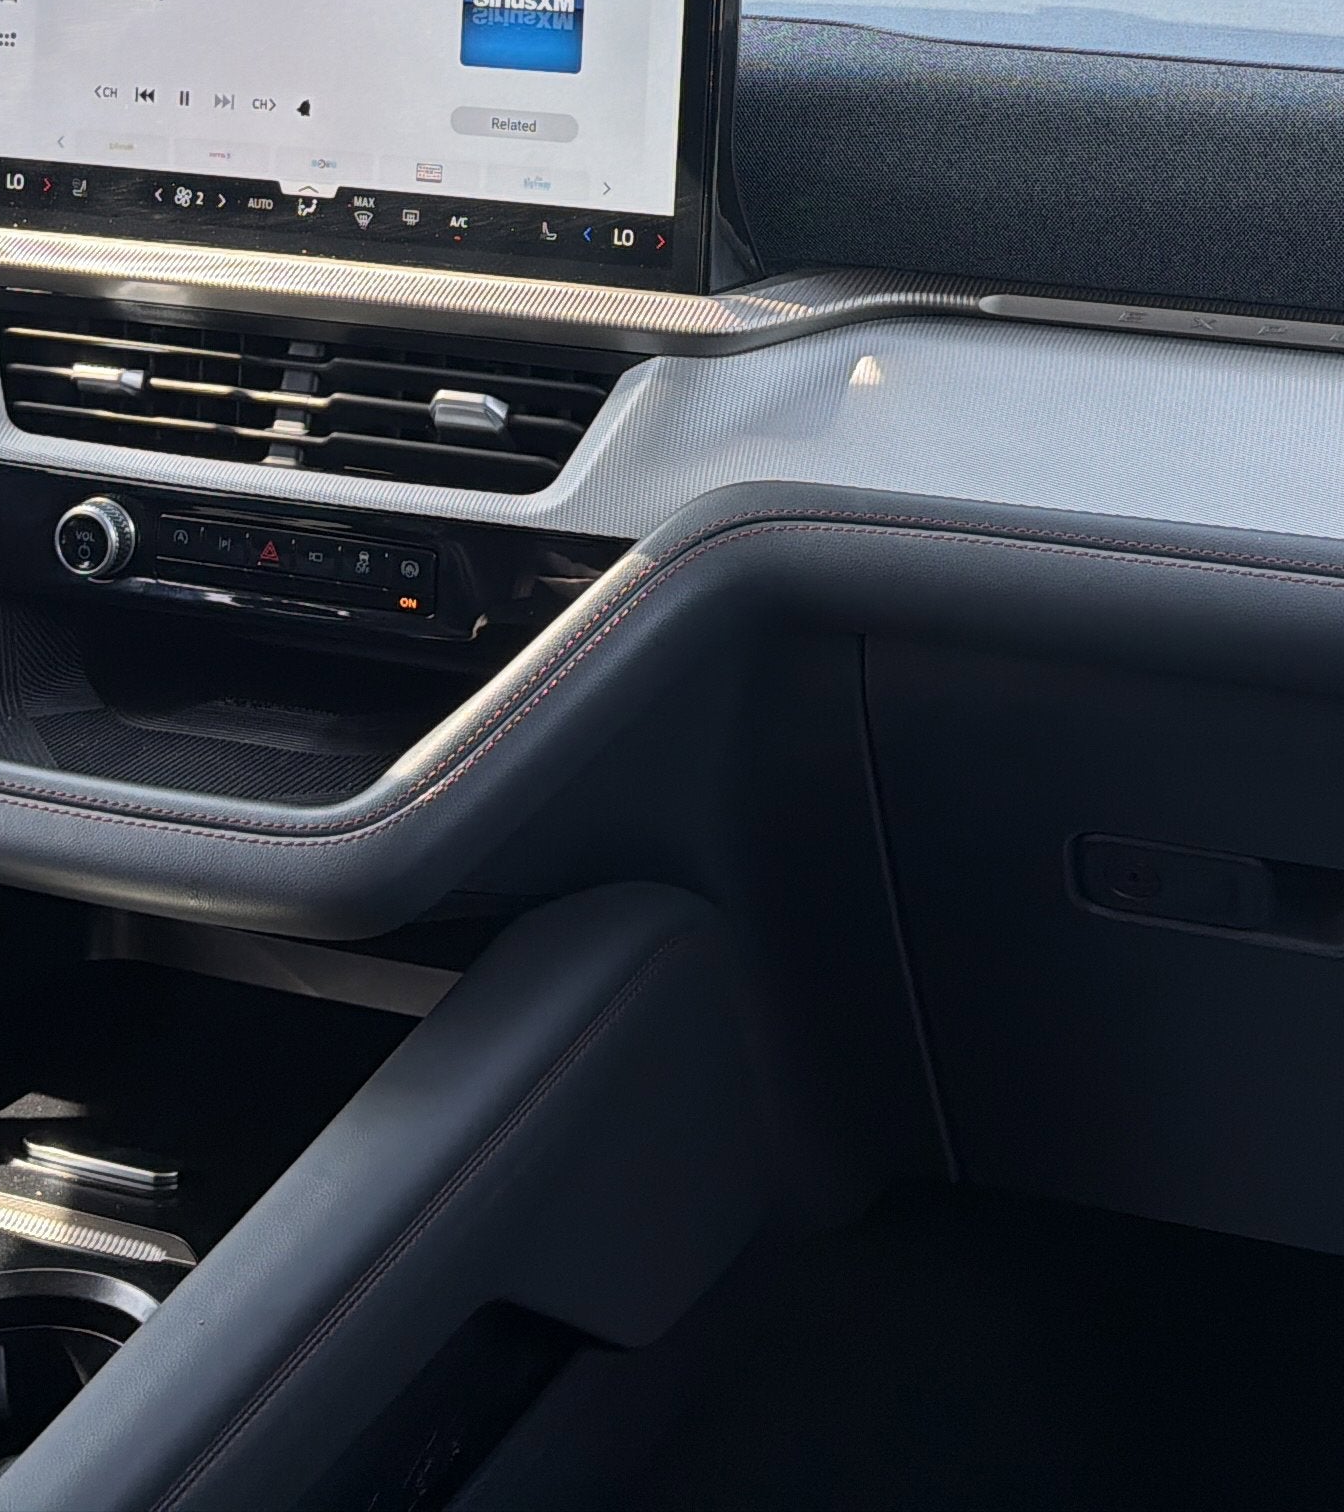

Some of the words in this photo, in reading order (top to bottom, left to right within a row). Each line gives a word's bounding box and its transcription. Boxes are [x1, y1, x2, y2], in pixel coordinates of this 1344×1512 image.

[102, 86, 118, 99] CH
[252, 98, 268, 110] CH
[491, 116, 537, 133] Related
[5, 172, 24, 192] LO
[196, 193, 205, 205] 2
[248, 198, 273, 210] AUTO
[353, 196, 375, 208] MAX
[449, 216, 468, 229] A/C
[613, 228, 634, 247] LO
[75, 530, 96, 541] VOL
[399, 597, 417, 609] ON
